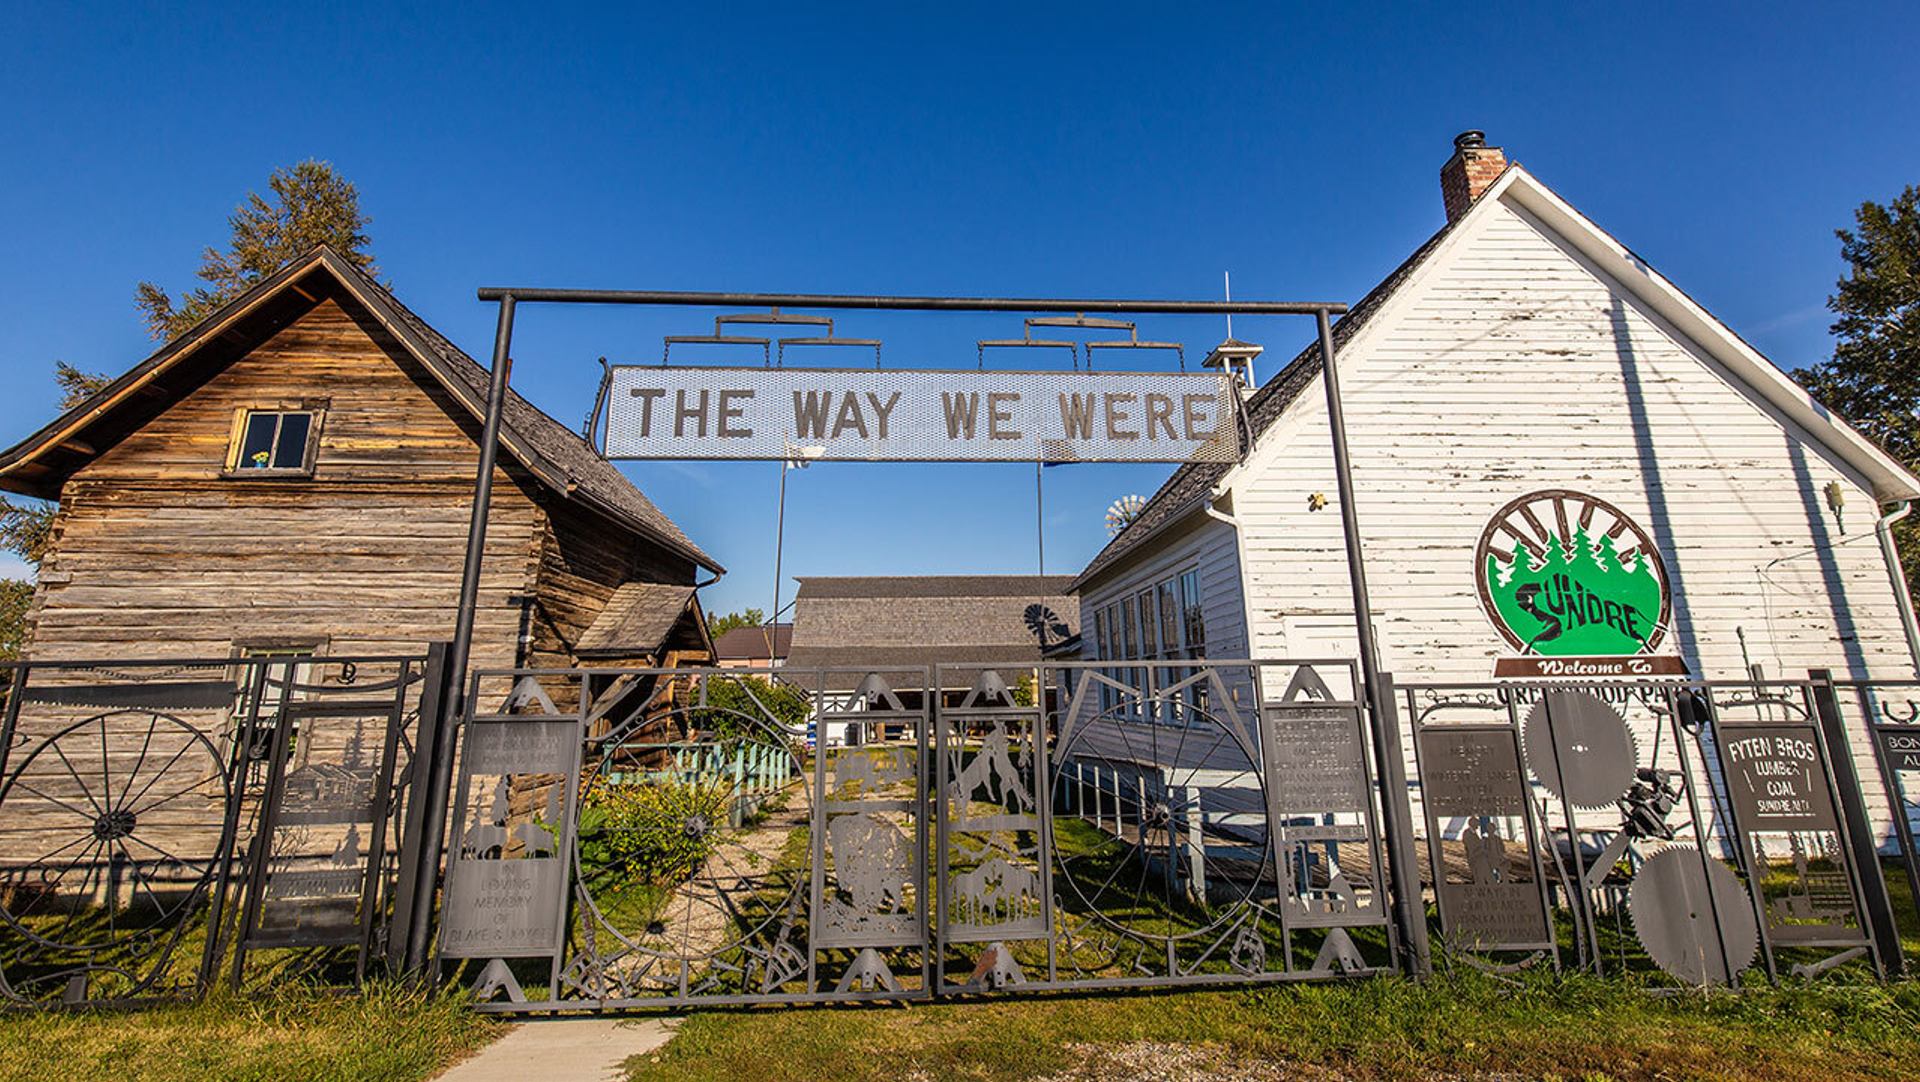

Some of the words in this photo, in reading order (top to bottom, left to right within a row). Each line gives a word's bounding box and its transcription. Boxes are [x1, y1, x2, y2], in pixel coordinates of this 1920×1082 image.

[630, 387, 756, 439] THE
[792, 389, 902, 441] WAY
[942, 391, 1022, 441] WE
[1059, 392, 1219, 442] WERE
[1514, 572, 1641, 642] SUNDRE
[1537, 660, 1623, 675] Welcome
[1627, 659, 1653, 674] To
[1727, 736, 1773, 763] FYTEN
[1774, 735, 1816, 762] BROS
[1754, 760, 1801, 776] LUMBER
[1766, 780, 1797, 797] COAL
[1757, 799, 1791, 812] SUNDRE
[481, 878, 532, 892] LOVING
[474, 896, 533, 910] MEMORY
[492, 913, 510, 925] OF
[449, 929, 488, 942] BLAKE
